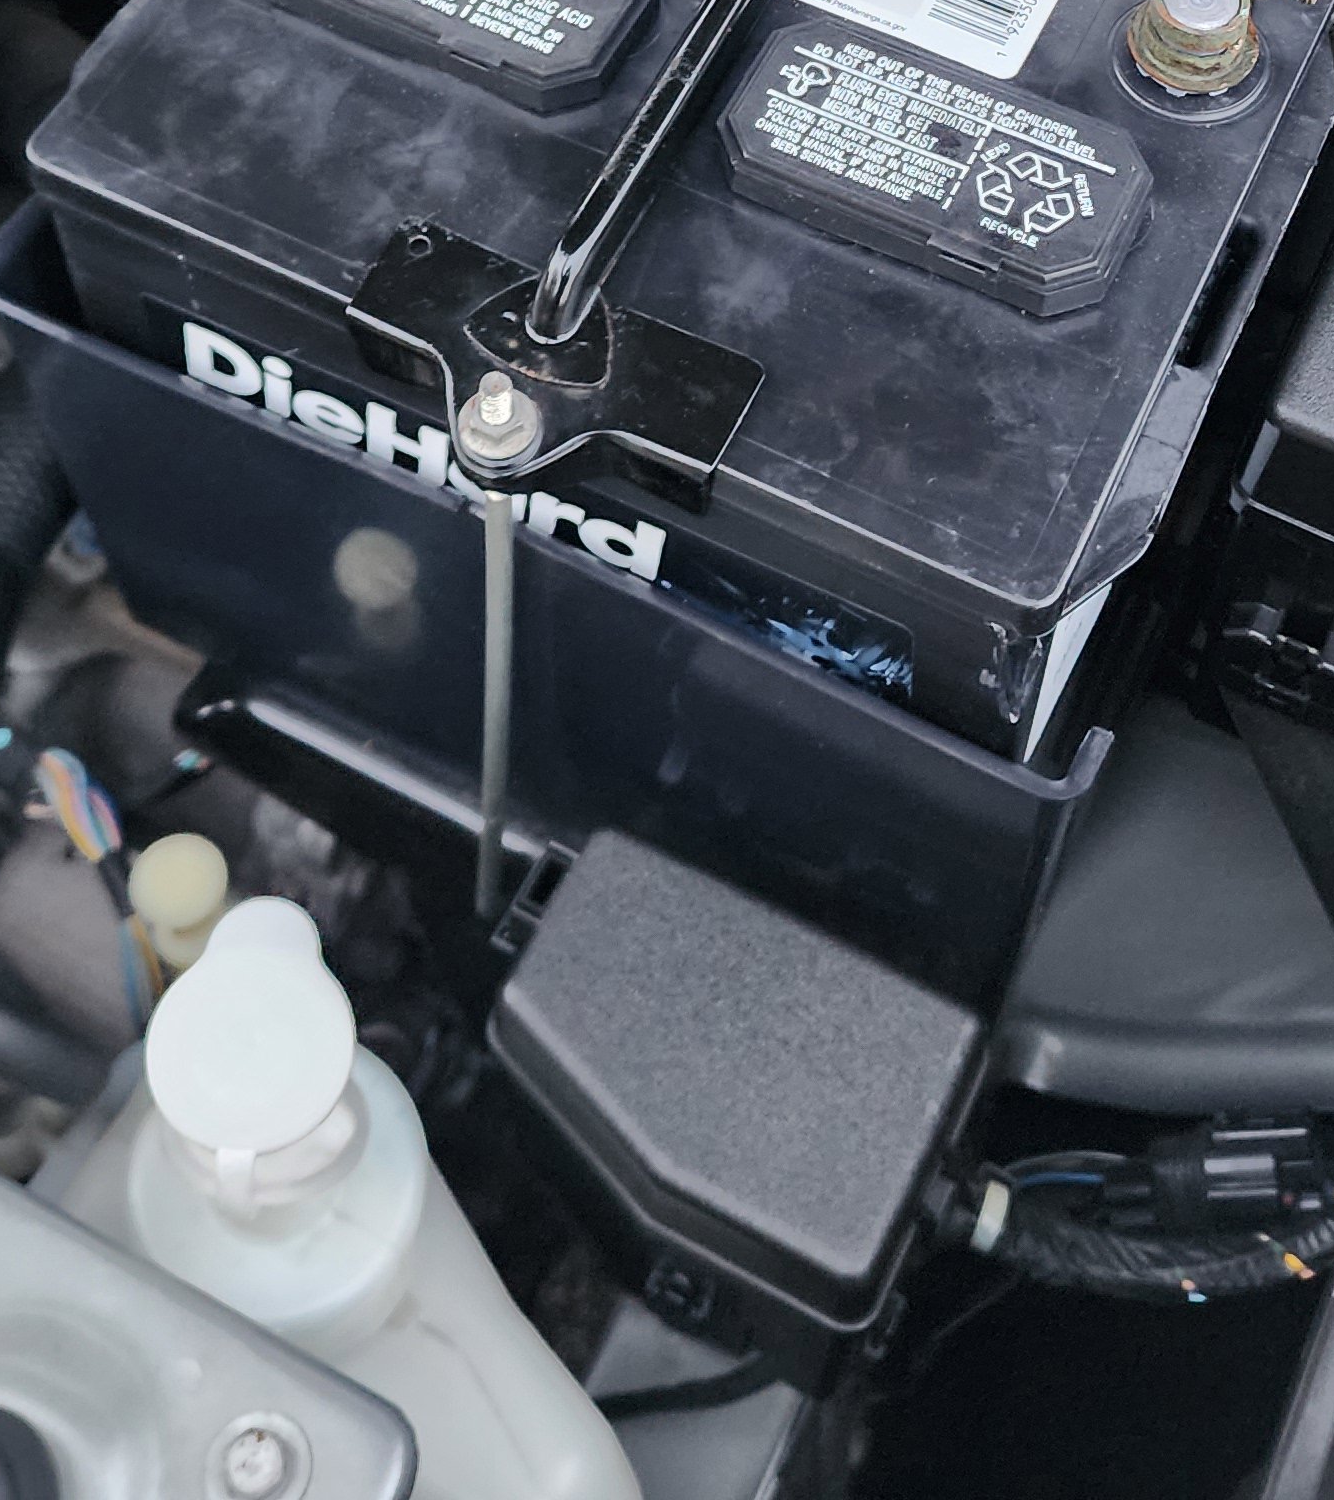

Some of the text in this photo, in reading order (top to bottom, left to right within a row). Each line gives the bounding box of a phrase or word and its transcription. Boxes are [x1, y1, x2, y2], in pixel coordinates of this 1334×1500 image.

[468, 12, 556, 55] SEVERE BURNS
[477, 2, 565, 44] BLINDNESS OR
[511, 1, 554, 27] CAUSE
[556, 7, 595, 30] ACID
[812, 42, 833, 59] DO
[833, 50, 861, 70] NOT
[885, 70, 920, 91] KEEP
[920, 82, 957, 105] VENT
[955, 96, 990, 118] CAPS
[990, 110, 1027, 134] TIGHT
[1028, 125, 1057, 146] AND
[1054, 138, 1096, 162] LEVEL
[829, 84, 862, 107] WITH
[905, 113, 933, 134] GET
[835, 72, 986, 137] FLUSH EYES IMMEDIATELY
[844, 42, 1078, 141] KEEP OUT OF THE REACH OF CHILDREN
[817, 117, 842, 134] FOR
[840, 126, 871, 145] SAFE
[869, 138, 902, 157] JUMP
[900, 150, 956, 179] STARTING
[821, 97, 939, 151] MEDICAL HELP FAST
[754, 117, 802, 143] OWNERS
[848, 156, 864, 168] IF
[862, 161, 888, 177] NOT
[887, 169, 946, 201] AVAILABLE
[765, 109, 948, 188] FOLLOW INSTRUCTIONS IN VEHICLE
[770, 136, 801, 157] SEEK
[799, 148, 848, 176] SERVICE
[979, 141, 1011, 164] LEAD
[1073, 172, 1095, 219] RETURN
[979, 216, 1039, 249] RECYCLE
